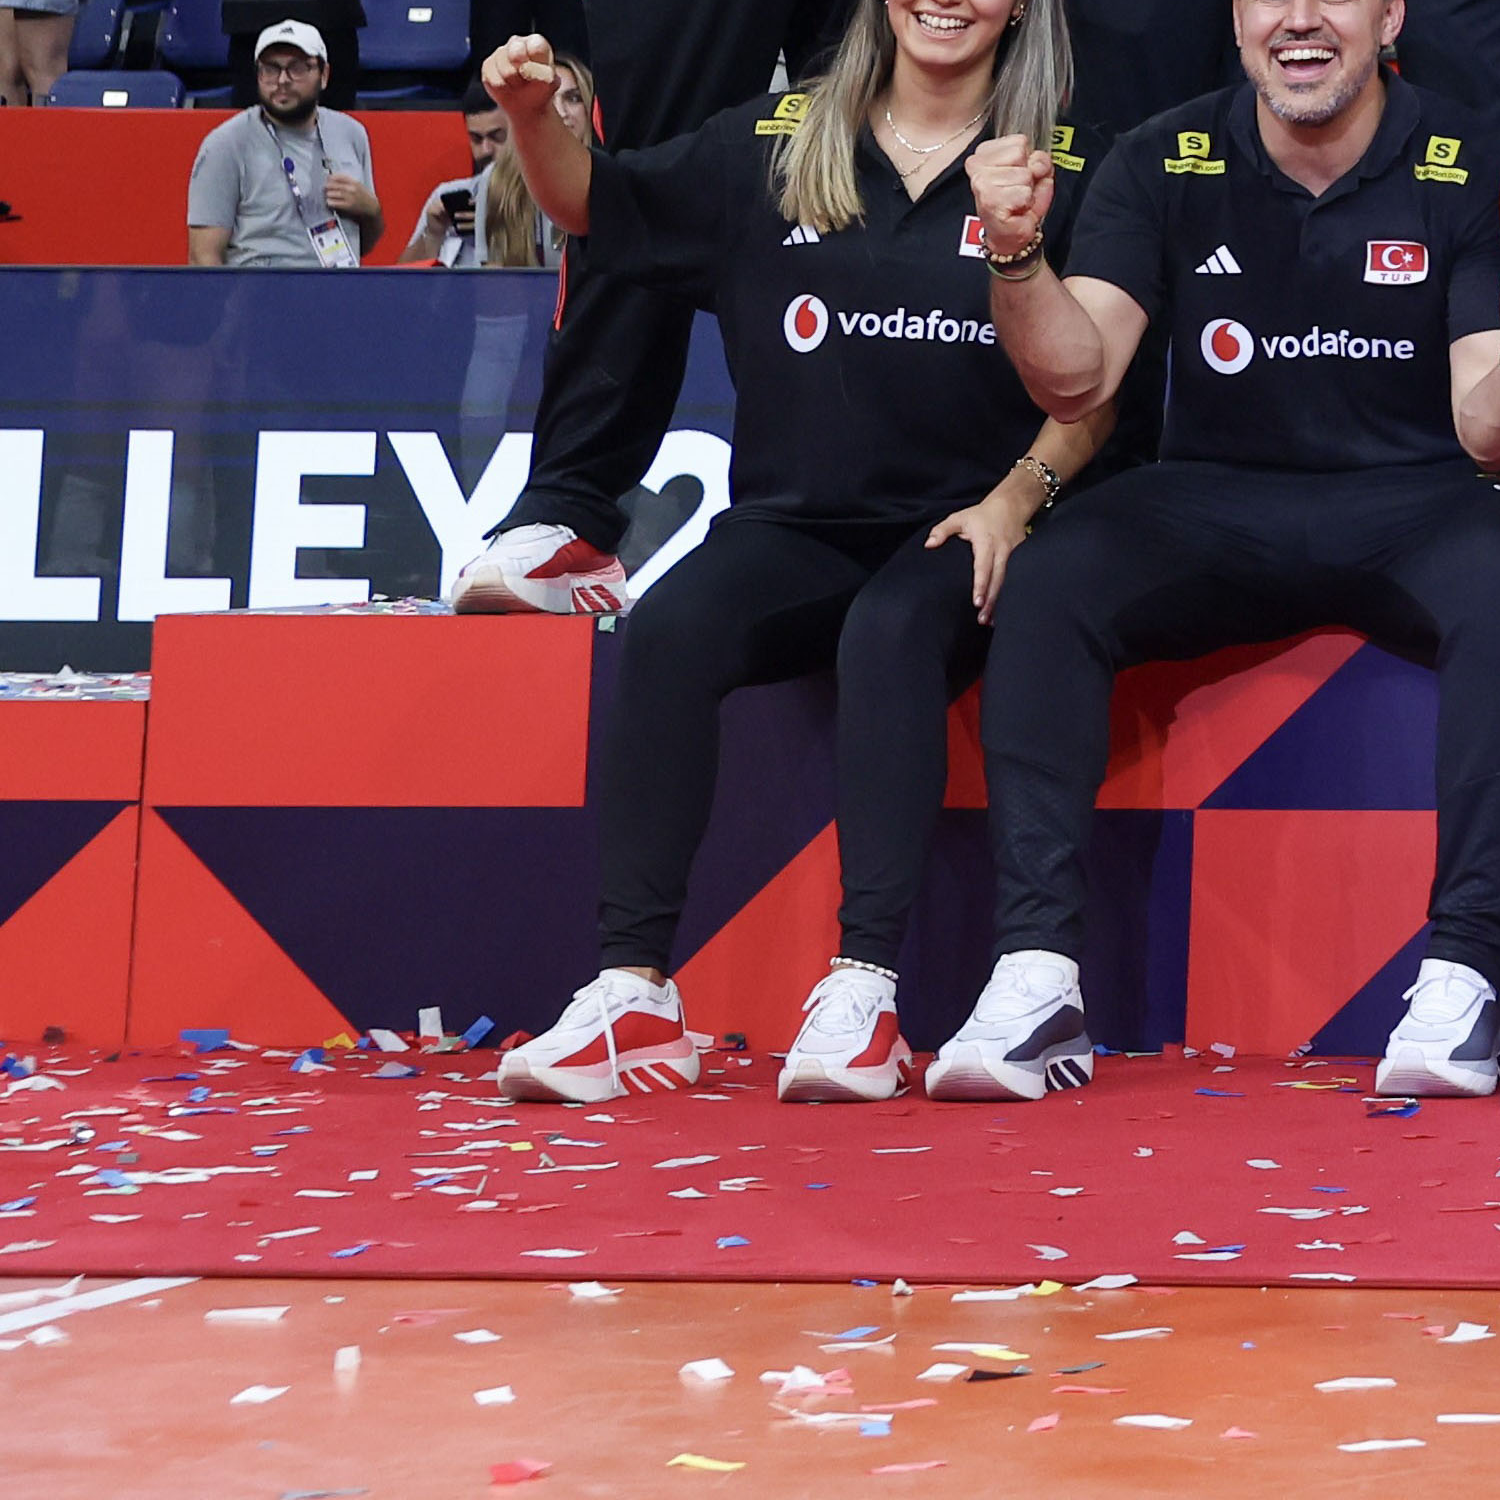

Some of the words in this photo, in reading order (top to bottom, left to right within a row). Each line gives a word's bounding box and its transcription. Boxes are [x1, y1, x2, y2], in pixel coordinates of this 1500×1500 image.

[788, 100, 803, 114] S
[1187, 134, 1203, 153] S
[1435, 141, 1452, 160] S
[1380, 273, 1424, 285] TUR
[840, 309, 999, 347] vodafone
[1262, 327, 1415, 360] vodafone
